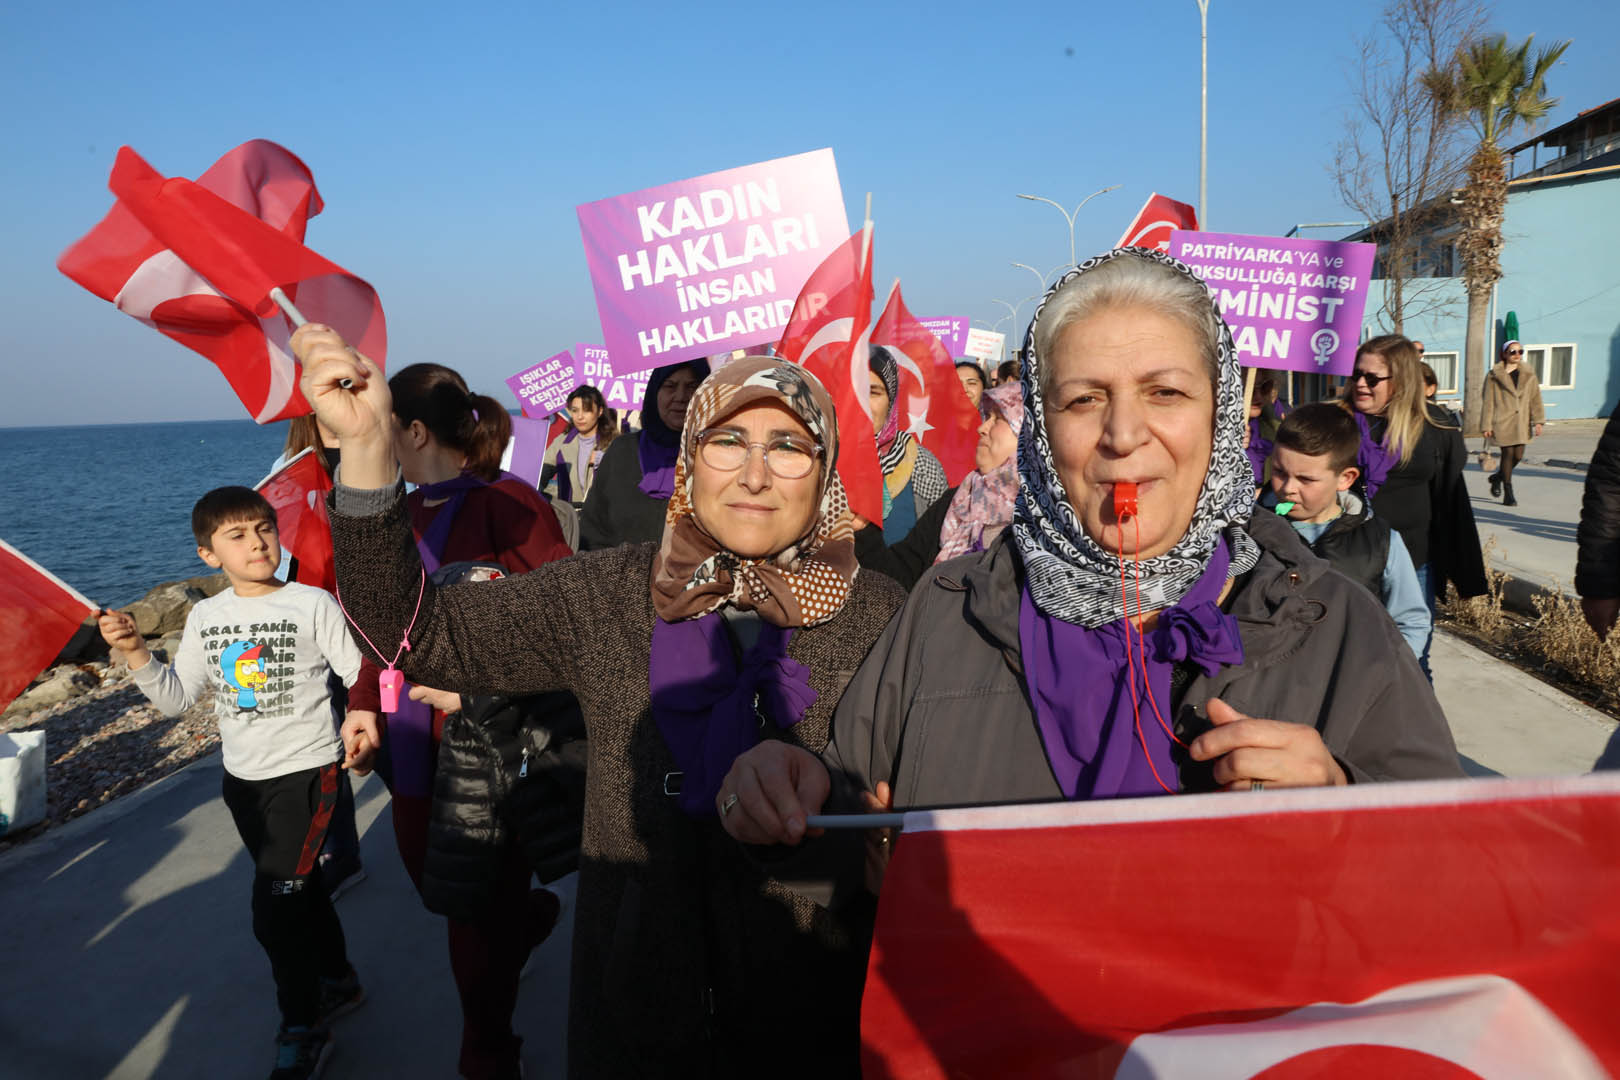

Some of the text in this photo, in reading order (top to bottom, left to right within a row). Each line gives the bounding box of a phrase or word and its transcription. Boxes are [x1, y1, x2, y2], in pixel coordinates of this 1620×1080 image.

[637, 177, 782, 243] KADIN
[617, 212, 820, 291] HAKLARI
[1324, 255, 1344, 269] ve
[675, 267, 777, 313] İNSAN
[1187, 262, 1358, 294] OKSULLUĞA KARŞI
[638, 292, 831, 357] HAKLARIDIR
[584, 348, 609, 360] FITR
[519, 366, 575, 398] SOKAKLAR
[200, 619, 298, 638] KRAL ŞAKİR
